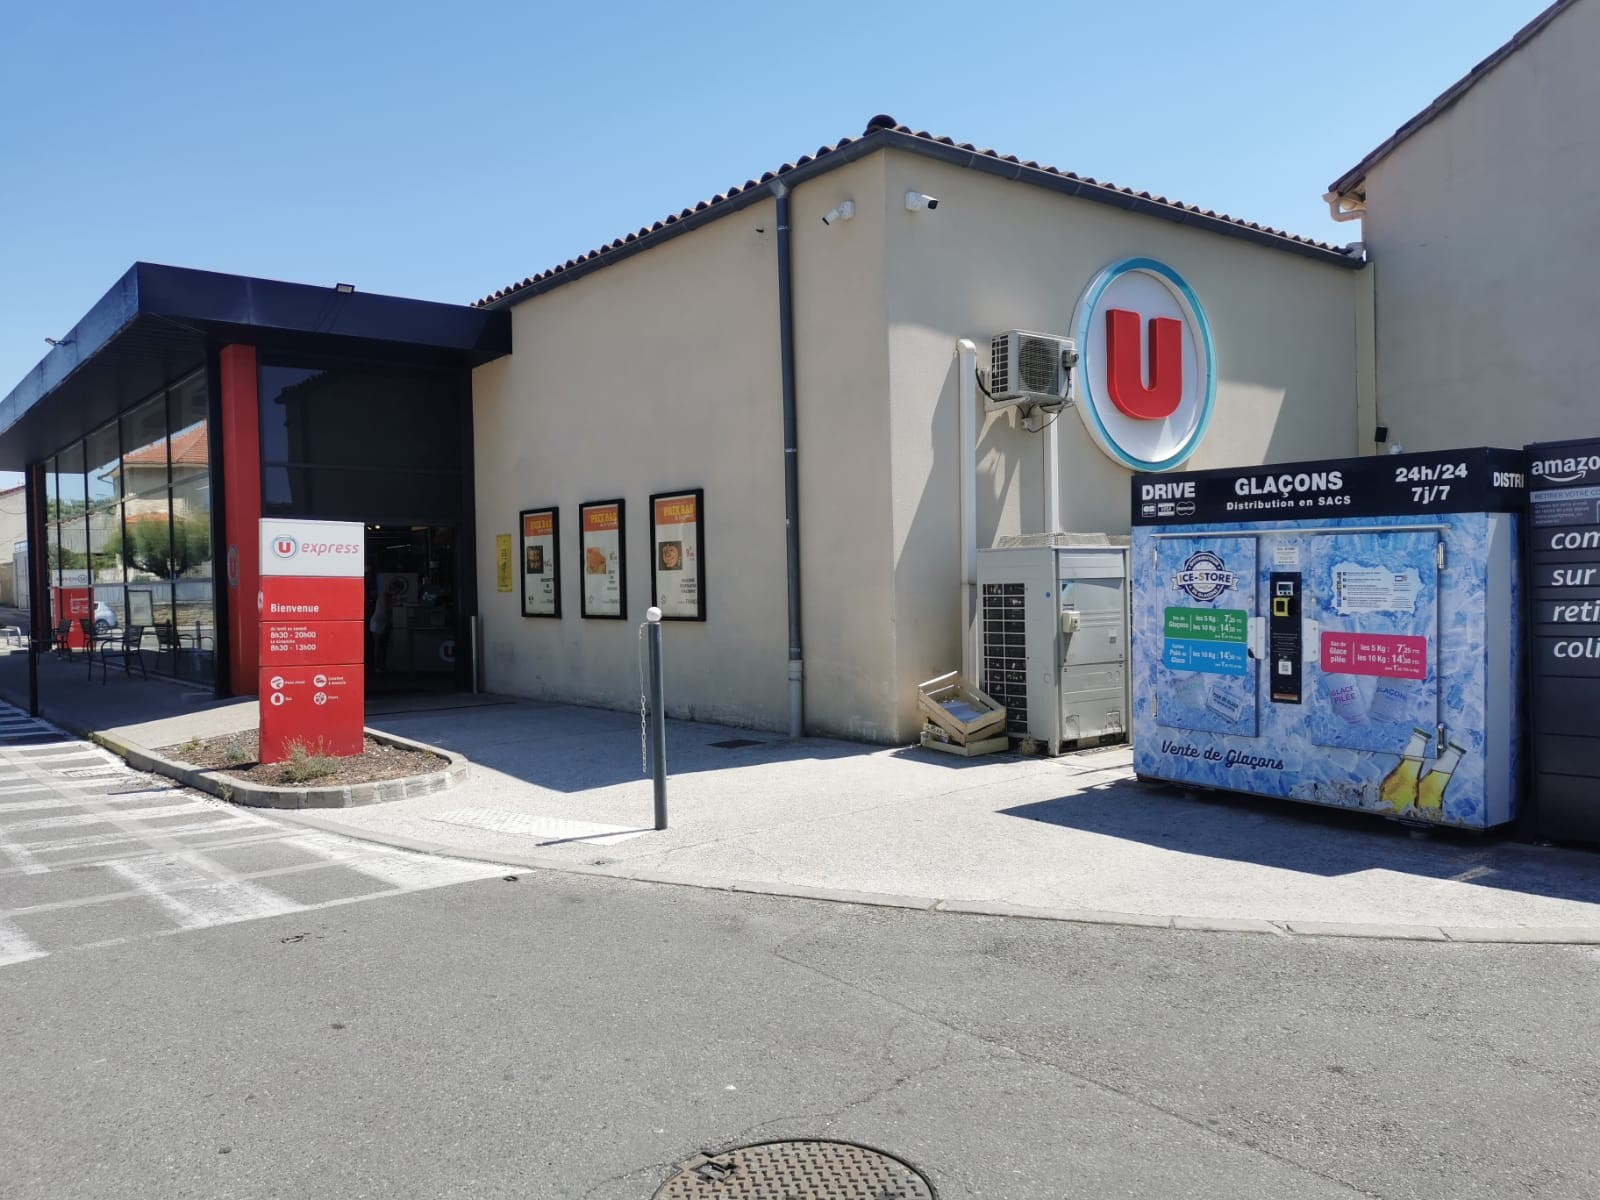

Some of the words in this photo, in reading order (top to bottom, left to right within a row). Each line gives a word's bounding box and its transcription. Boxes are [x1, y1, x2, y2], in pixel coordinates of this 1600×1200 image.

[1105, 308, 1182, 420] U
[1395, 463, 1468, 483] 24h/24
[1531, 455, 1600, 476] amazo
[1235, 471, 1343, 498] GLAÇONS
[1493, 471, 1524, 489] DISTRI
[1142, 482, 1195, 501] DRIVE
[1411, 485, 1450, 504] 7j/7
[1226, 499, 1294, 511] Distribution
[1299, 498, 1313, 507] en
[1318, 495, 1351, 506] SACS
[278, 541, 292, 554] U
[301, 542, 360, 556] express
[1551, 568, 1597, 586] sur
[270, 603, 320, 613] Bienvenue
[1161, 740, 1200, 758] Vente
[1203, 747, 1223, 761] de
[1225, 749, 1284, 770] Glaçons
